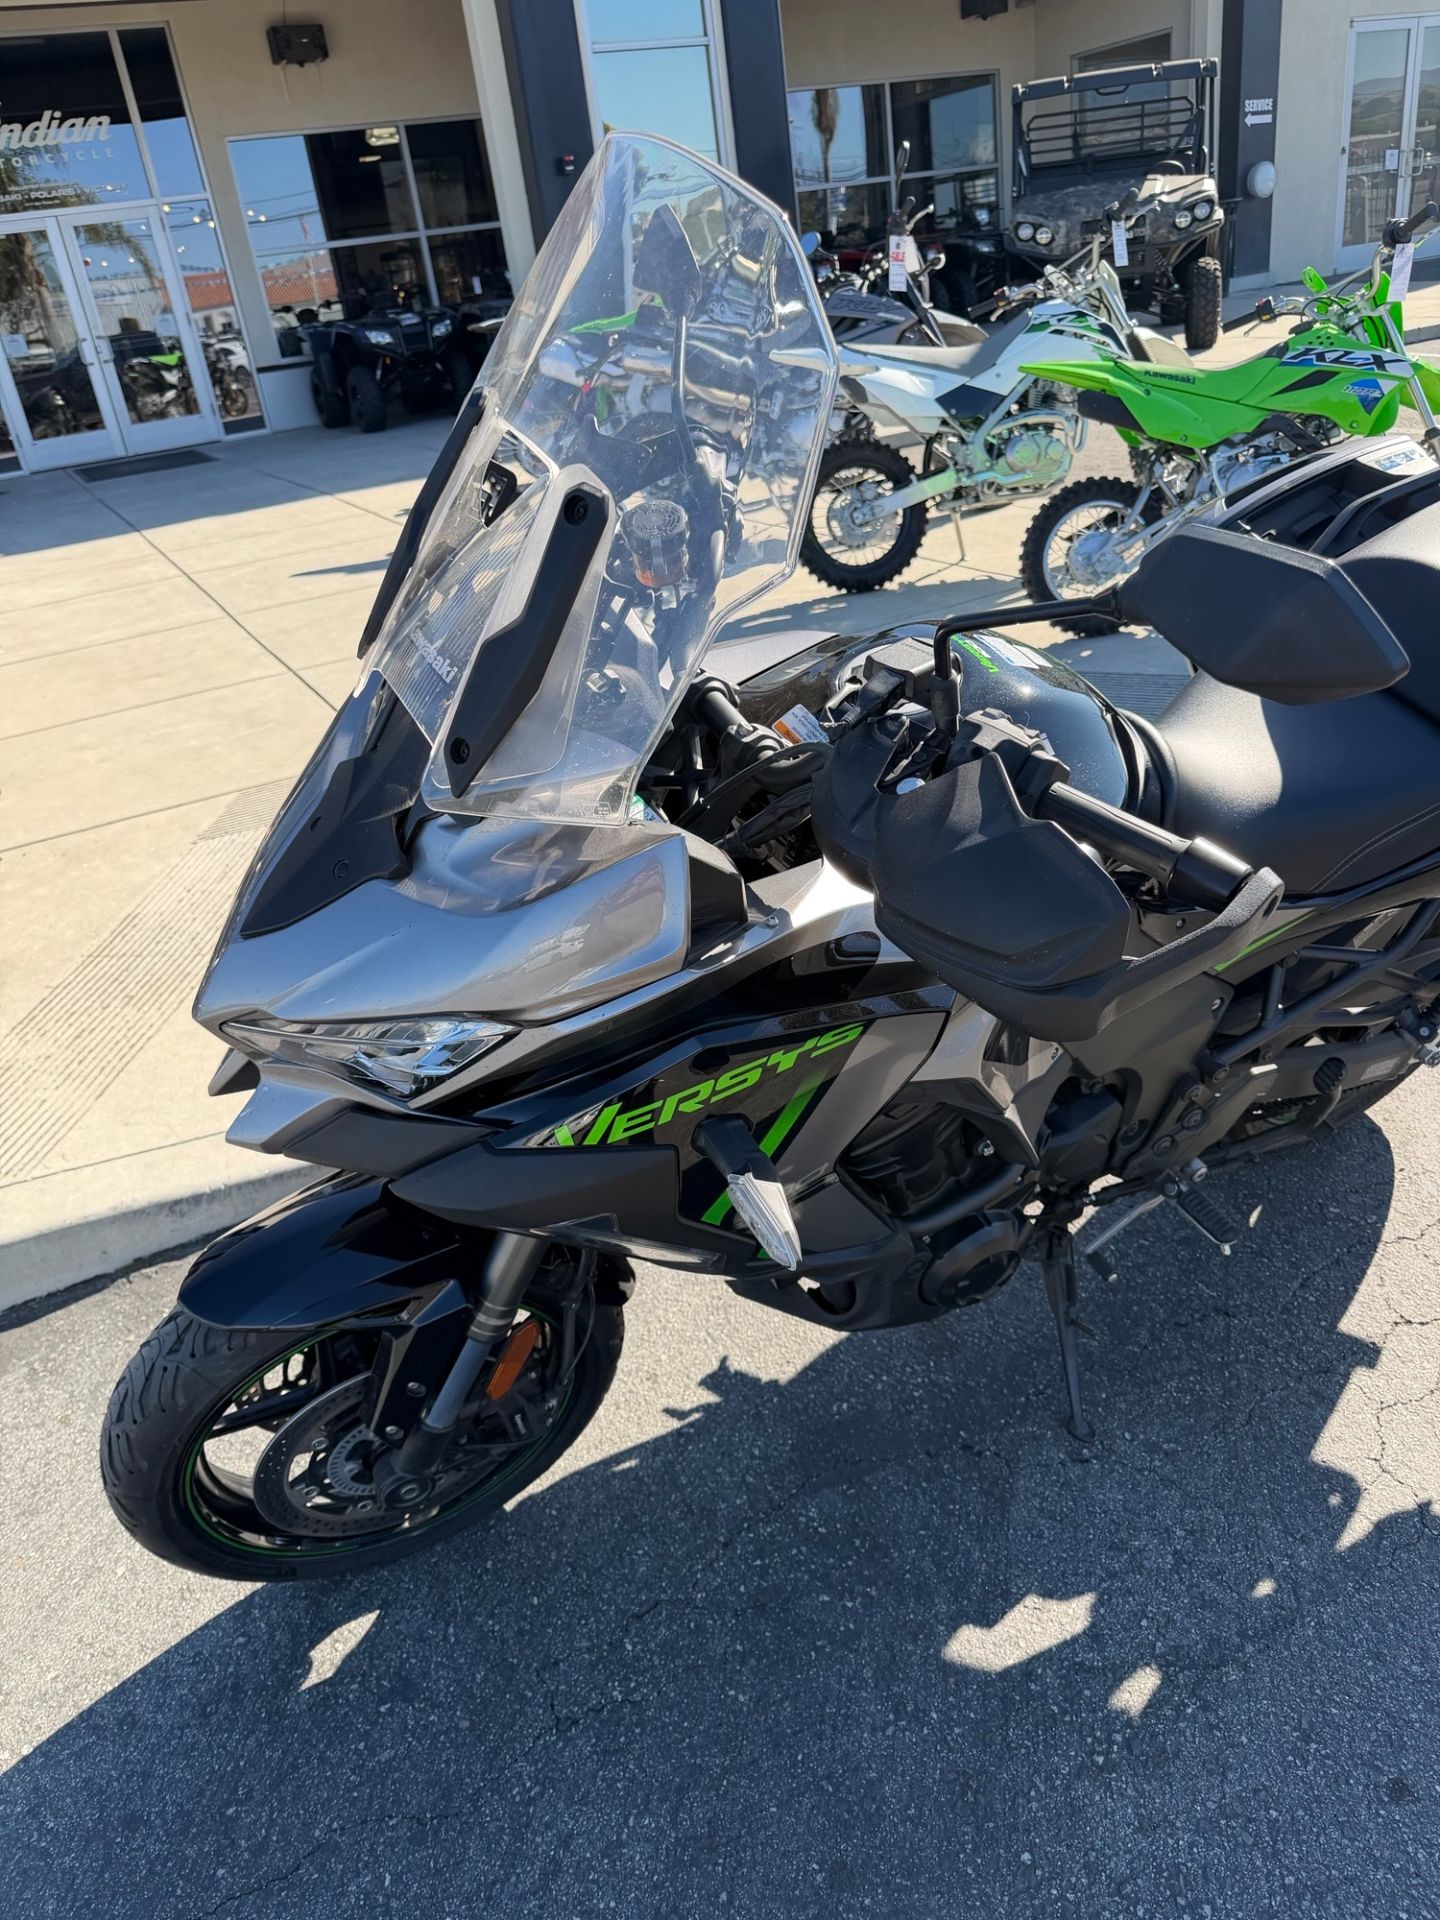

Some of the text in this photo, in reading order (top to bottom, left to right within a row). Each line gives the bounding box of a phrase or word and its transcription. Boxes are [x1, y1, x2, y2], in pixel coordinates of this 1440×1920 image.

[1244, 98, 1273, 112] SERVICE
[30, 188, 76, 200] POLARIS
[1287, 346, 1409, 374] KLX
[554, 1023, 864, 1146] VERSYS
